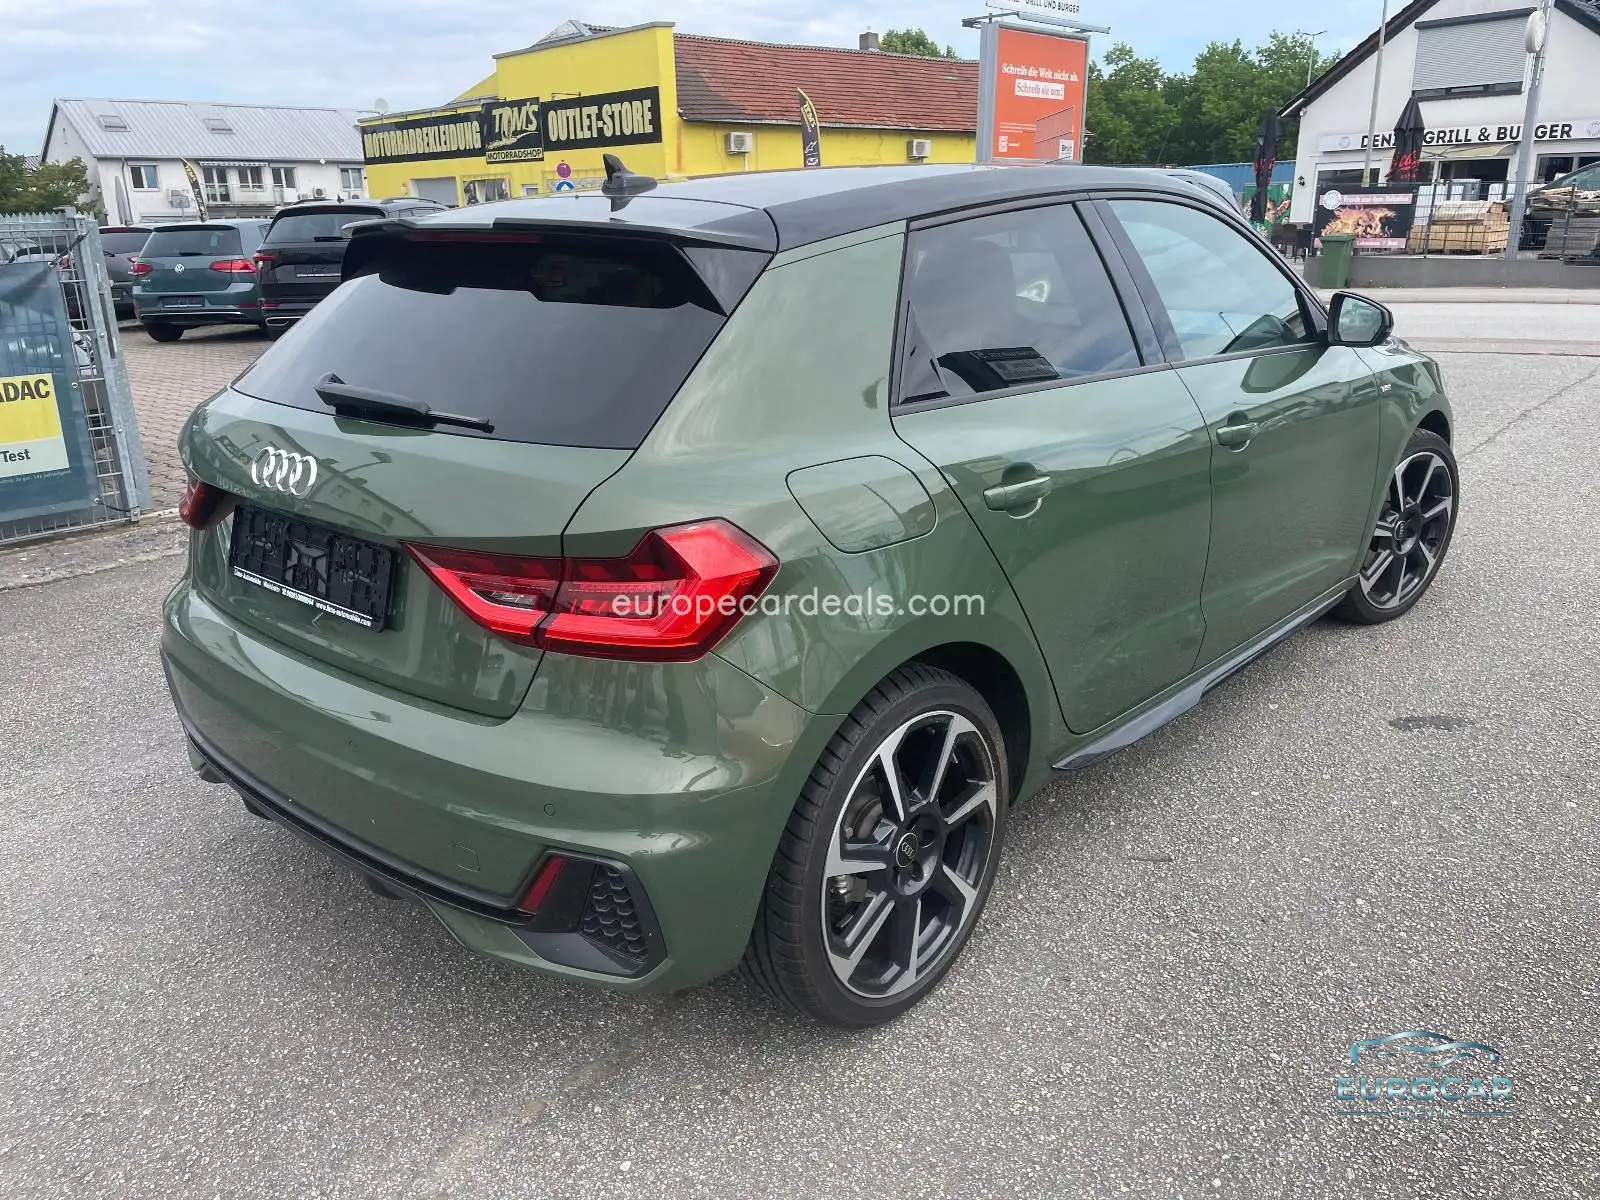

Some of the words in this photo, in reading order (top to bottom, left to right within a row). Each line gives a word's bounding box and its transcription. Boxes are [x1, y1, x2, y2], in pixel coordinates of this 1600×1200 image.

[1043, 0, 1057, 10] UND
[1057, 2, 1080, 13] BURGER
[1002, 63, 1028, 76] Schreib
[1028, 66, 1038, 77] die
[1039, 68, 1053, 79] Welt
[1054, 69, 1069, 80] nicht
[1070, 72, 1079, 82] ab.
[1017, 82, 1040, 95] Schreib
[1042, 85, 1050, 95] sie
[1051, 88, 1063, 97] um!
[492, 102, 539, 140] TOM'S
[548, 99, 653, 142] OUTLET-STORE
[364, 121, 481, 158] MOTORRADBEKLEIDUNG
[1423, 129, 1472, 144] GRILL
[1478, 127, 1491, 141] &
[1496, 123, 1573, 140] BUGER
[488, 149, 541, 160] MOTORRADSHOP
